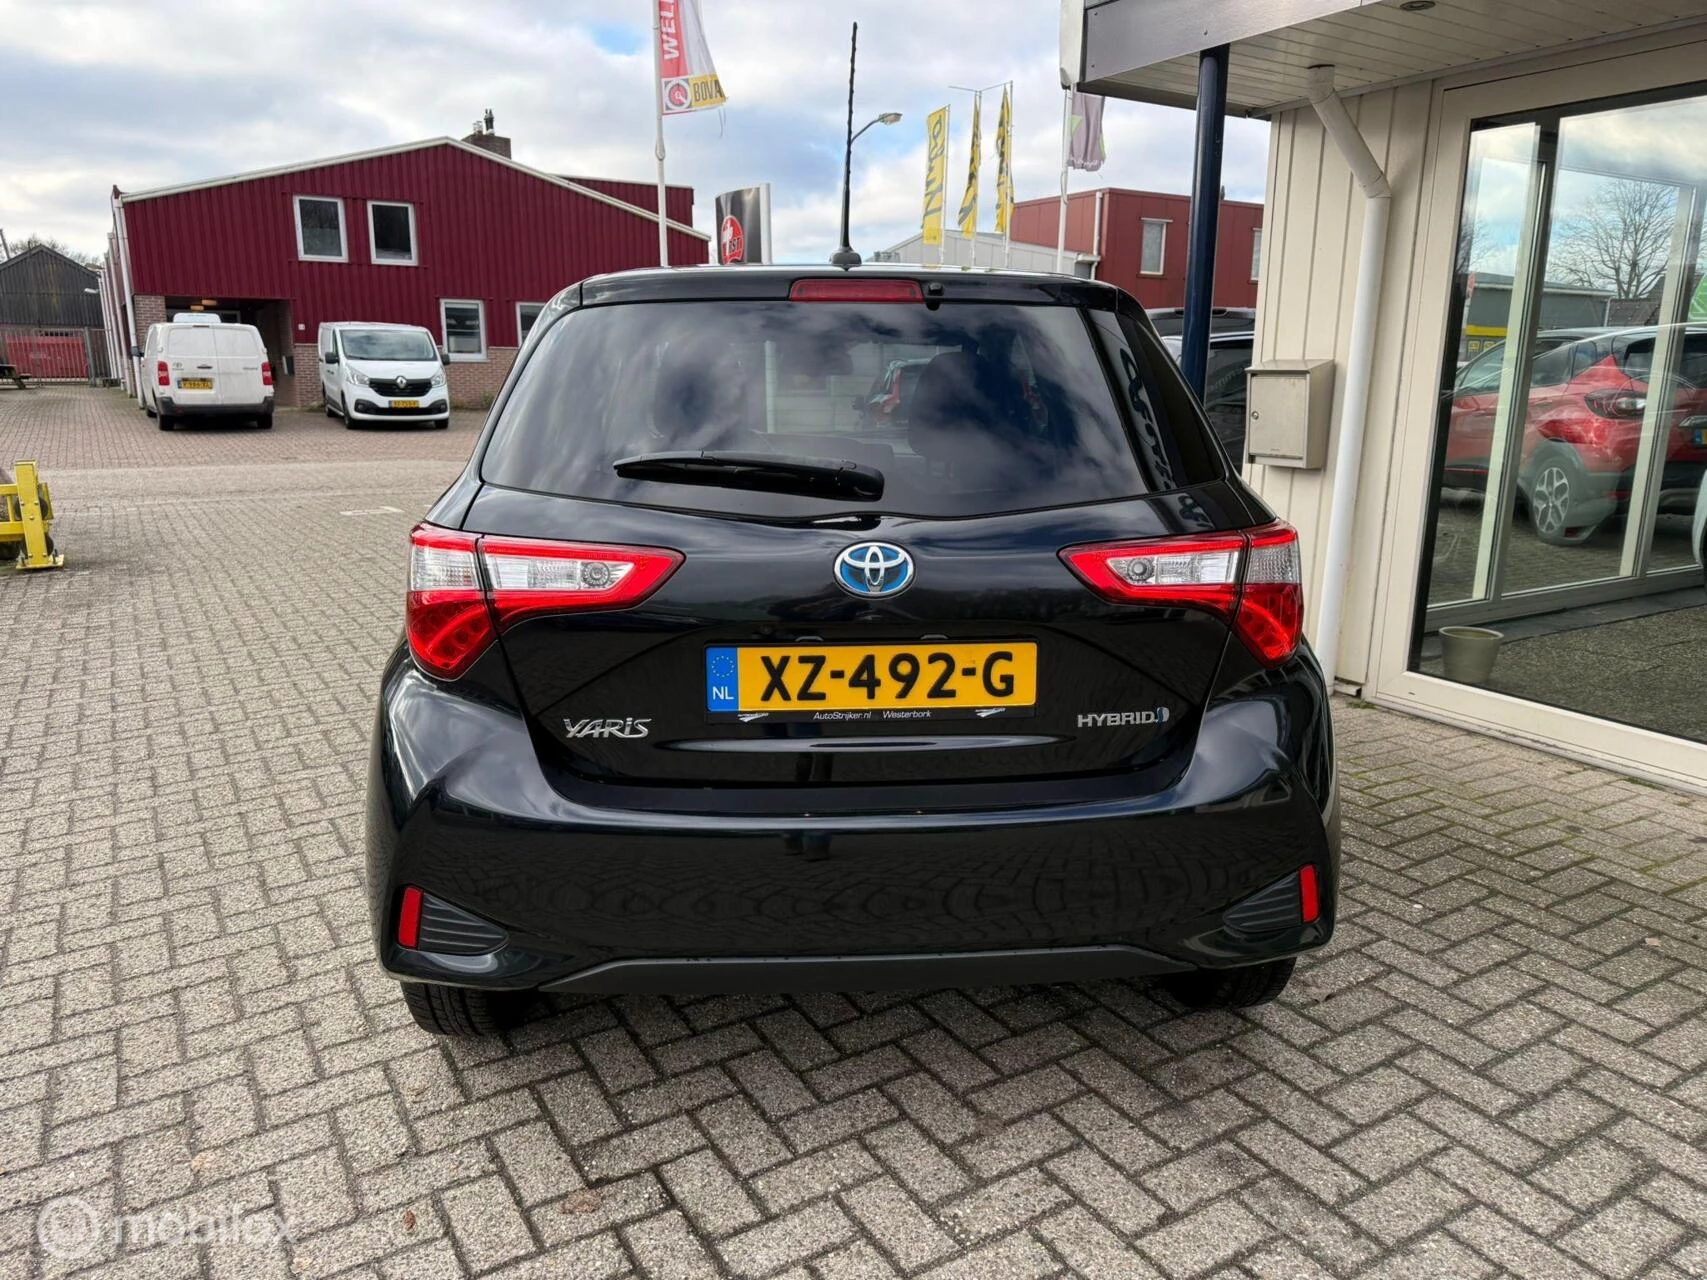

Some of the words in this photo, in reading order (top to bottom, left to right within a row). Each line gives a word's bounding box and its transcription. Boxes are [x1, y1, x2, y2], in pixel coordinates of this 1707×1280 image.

[760, 651, 1014, 702] XZ-492-G
[712, 686, 734, 701] NL
[813, 711, 872, 720] AutoStrijker.nl
[882, 710, 931, 719] Westerbork
[1077, 711, 1155, 728] HYBRID
